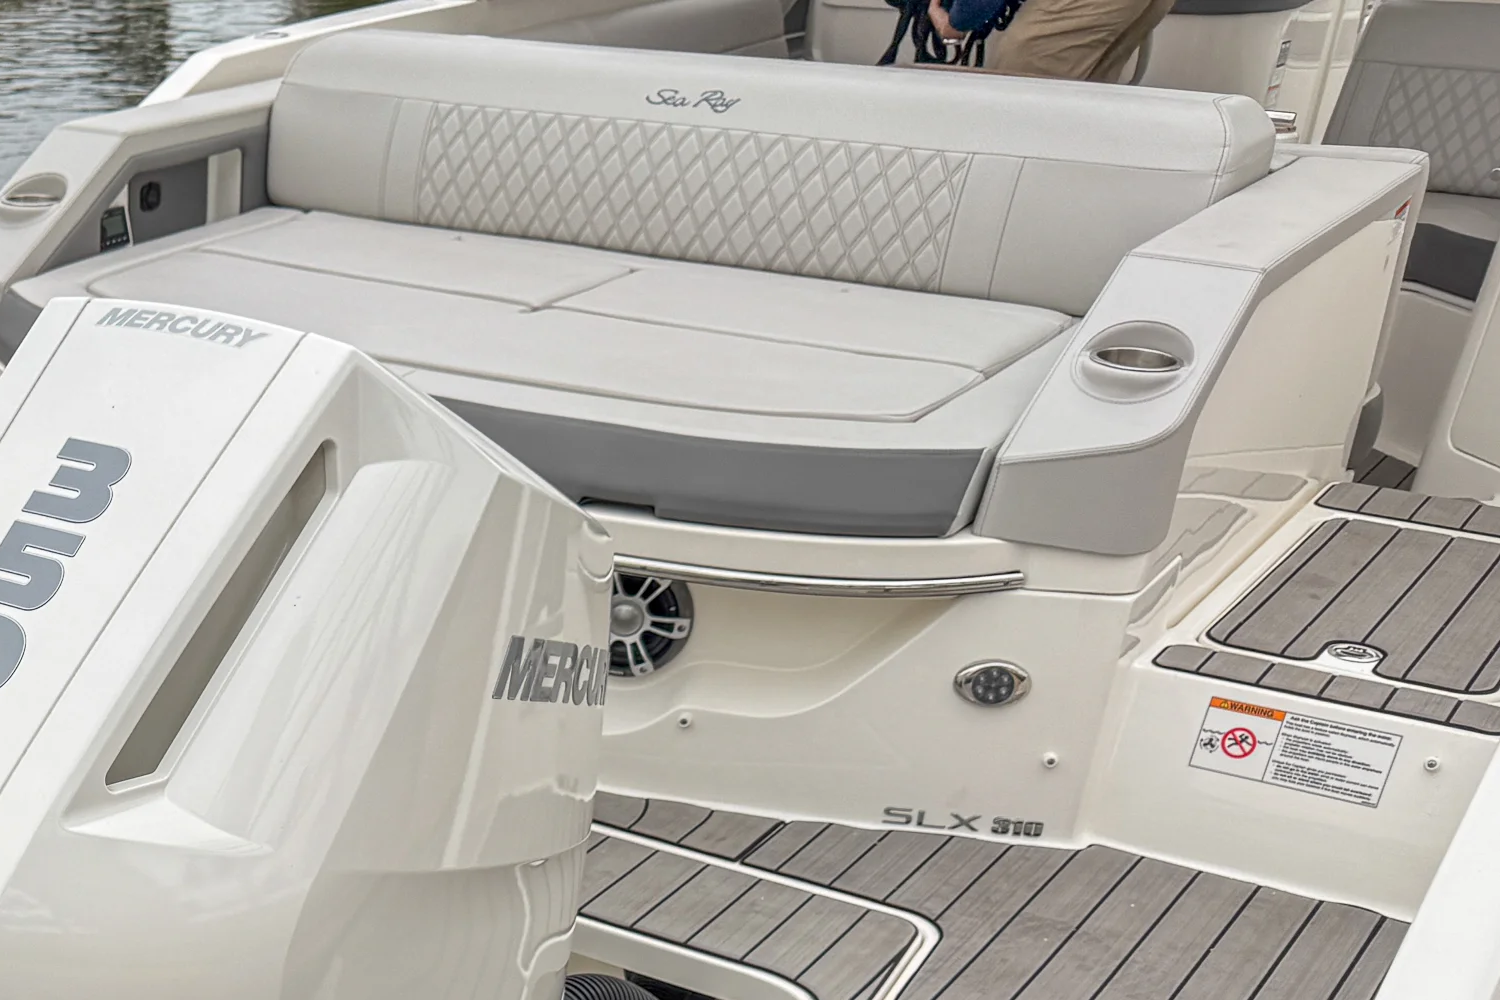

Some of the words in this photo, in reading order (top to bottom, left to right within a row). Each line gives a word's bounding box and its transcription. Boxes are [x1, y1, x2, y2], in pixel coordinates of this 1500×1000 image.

[645, 88, 691, 108] Sea
[692, 89, 742, 114] Ray
[95, 307, 270, 349] MERCURY
[1230, 701, 1274, 719] WARNING
[881, 806, 982, 832] SLX
[991, 815, 1045, 838] 310
